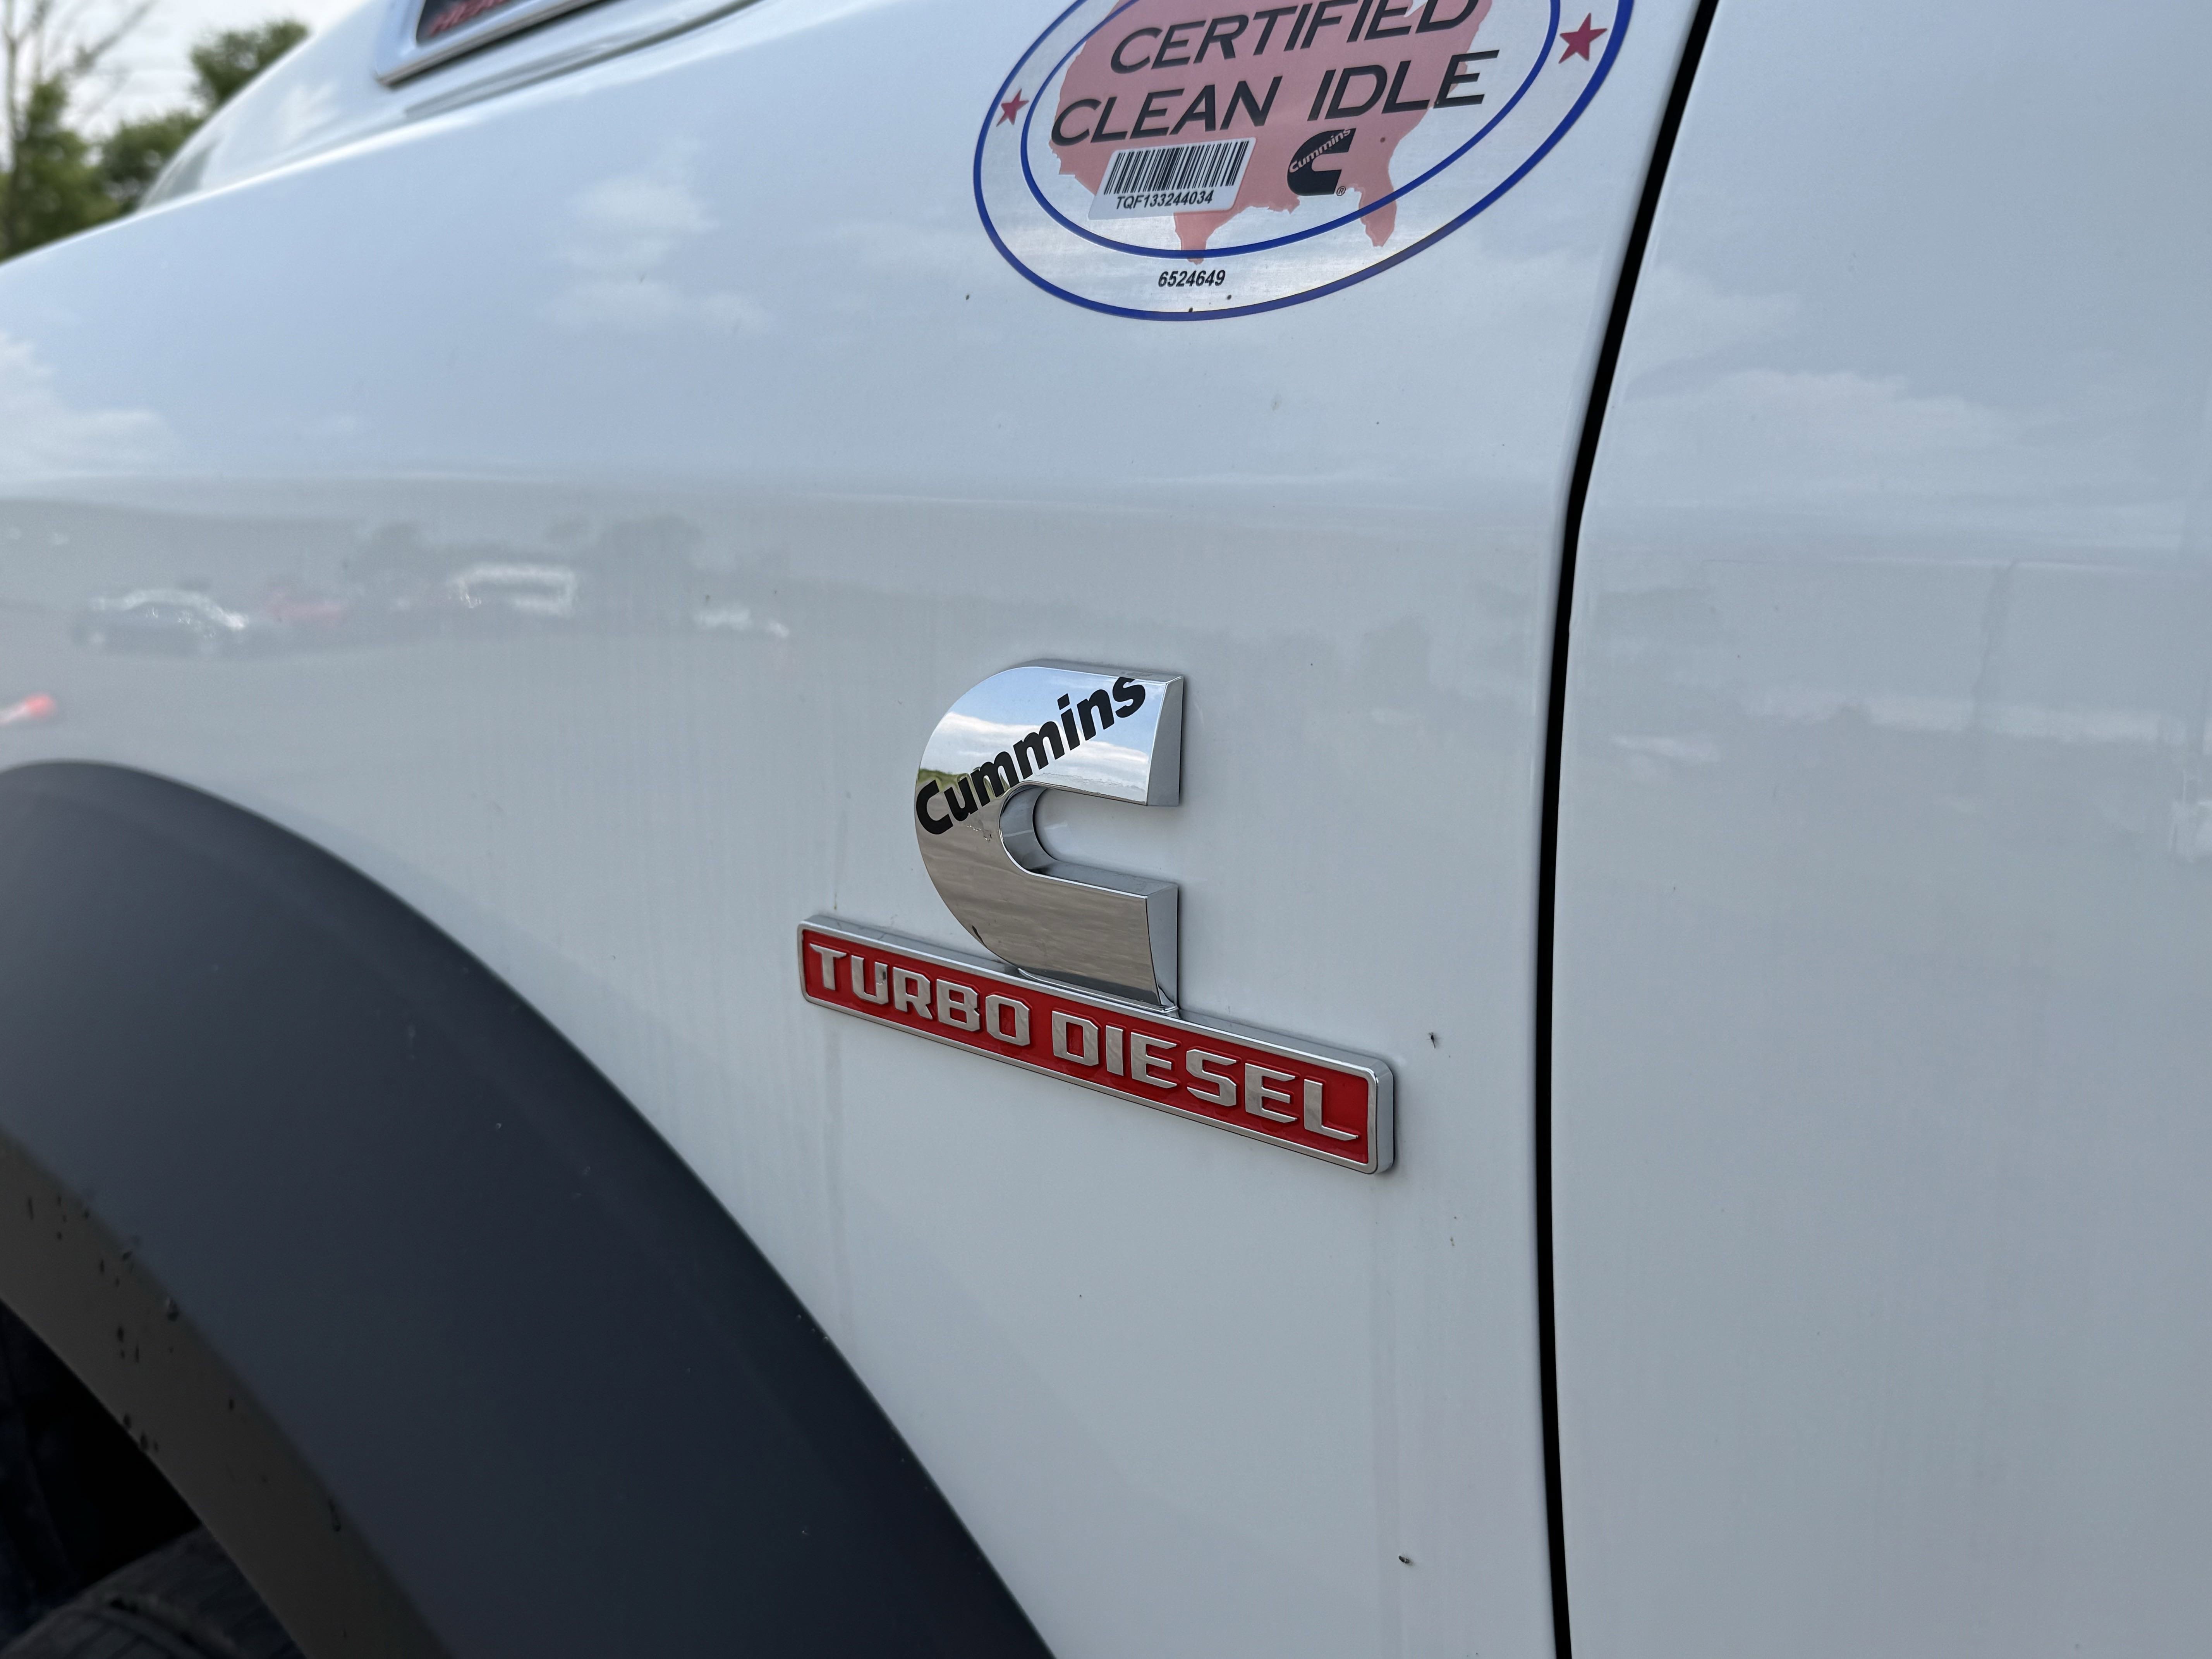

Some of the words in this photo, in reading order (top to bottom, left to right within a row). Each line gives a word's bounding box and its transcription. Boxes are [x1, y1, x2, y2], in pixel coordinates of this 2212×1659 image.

[1111, 0, 1479, 74] CERTIFIED
[1051, 76, 1283, 146] CLEAN
[1307, 50, 1499, 121] IDLE
[1289, 129, 1351, 173] Cummins
[1116, 190, 1214, 210] TQF133244034
[1158, 270, 1226, 287] 6524649
[915, 677, 1146, 835] Cummins
[809, 943, 1030, 1047] TURBO
[1051, 1010, 1359, 1142] DIESEL
